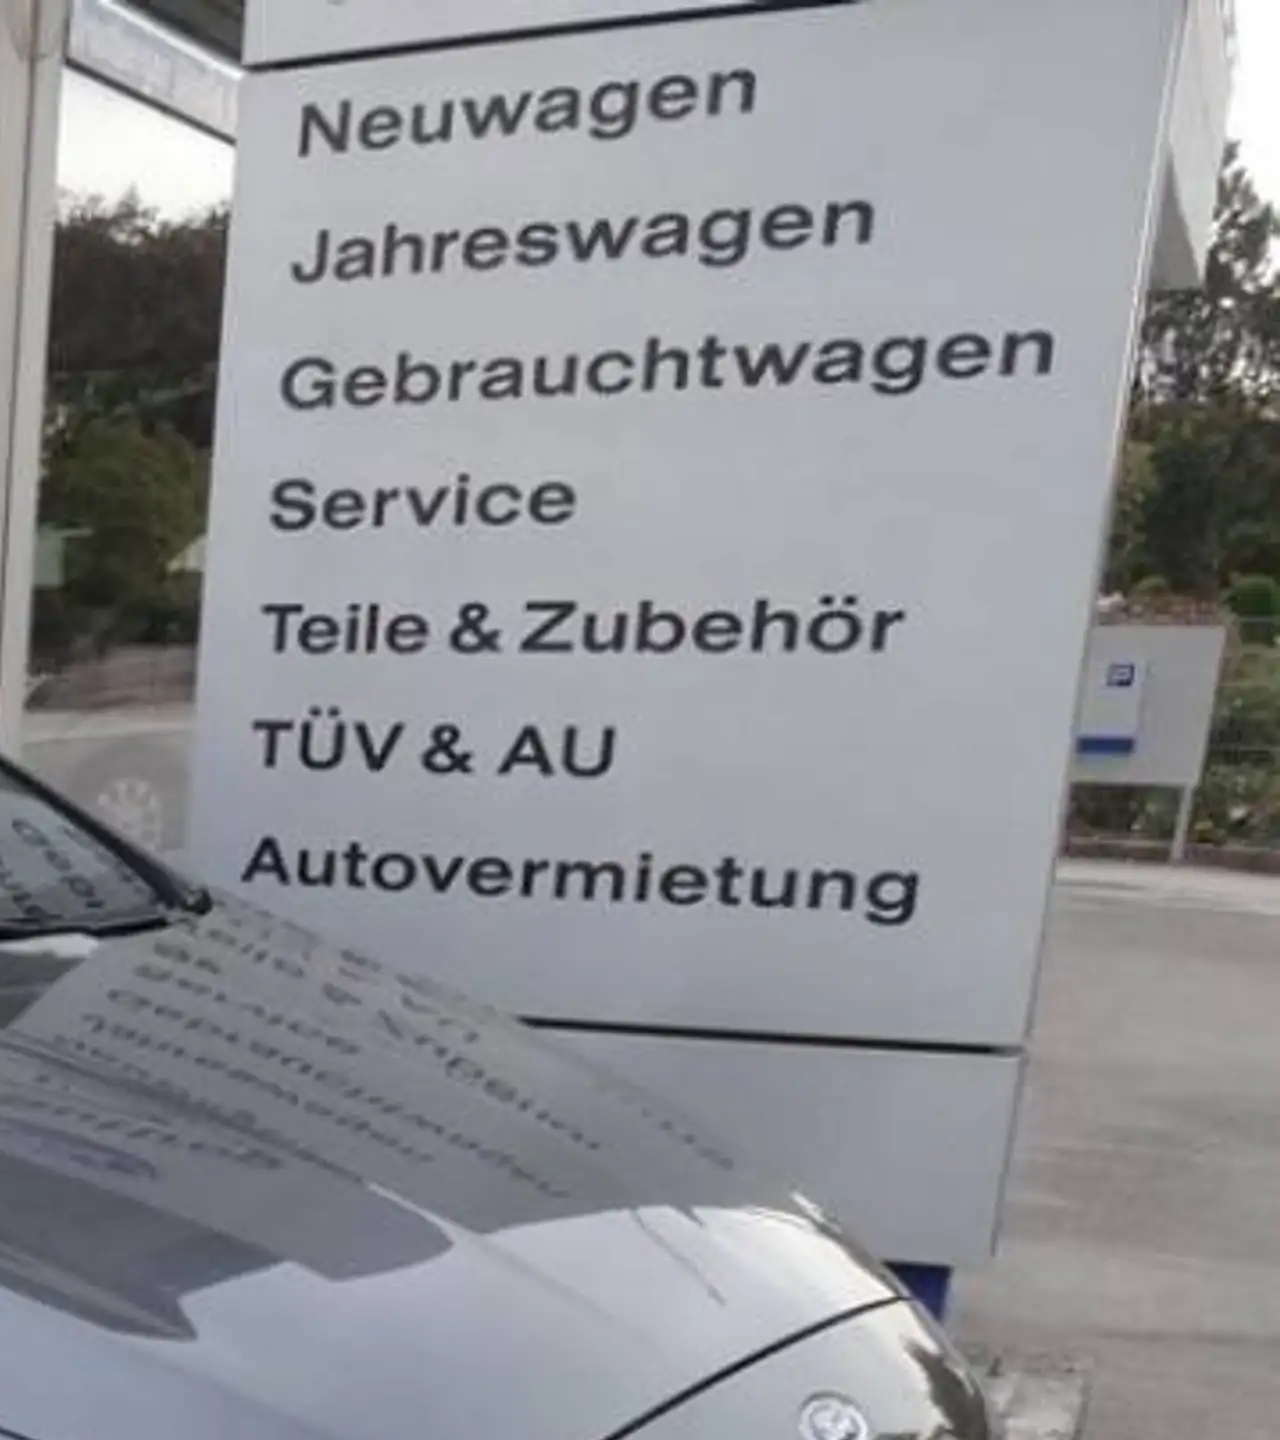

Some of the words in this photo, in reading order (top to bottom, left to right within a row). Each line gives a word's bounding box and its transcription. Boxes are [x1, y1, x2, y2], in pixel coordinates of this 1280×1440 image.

[296, 66, 758, 158] Neuwagen
[290, 199, 876, 285] Jahreswagen
[280, 328, 1055, 412] Gebrauchtwagen
[268, 473, 577, 533] Service
[261, 601, 430, 657] Teile
[447, 601, 501, 655] &
[518, 593, 906, 655] Zubehör
[250, 705, 407, 774] TÜV
[420, 722, 474, 776] &
[495, 723, 617, 779] AU
[241, 834, 921, 927] Autovermietung
